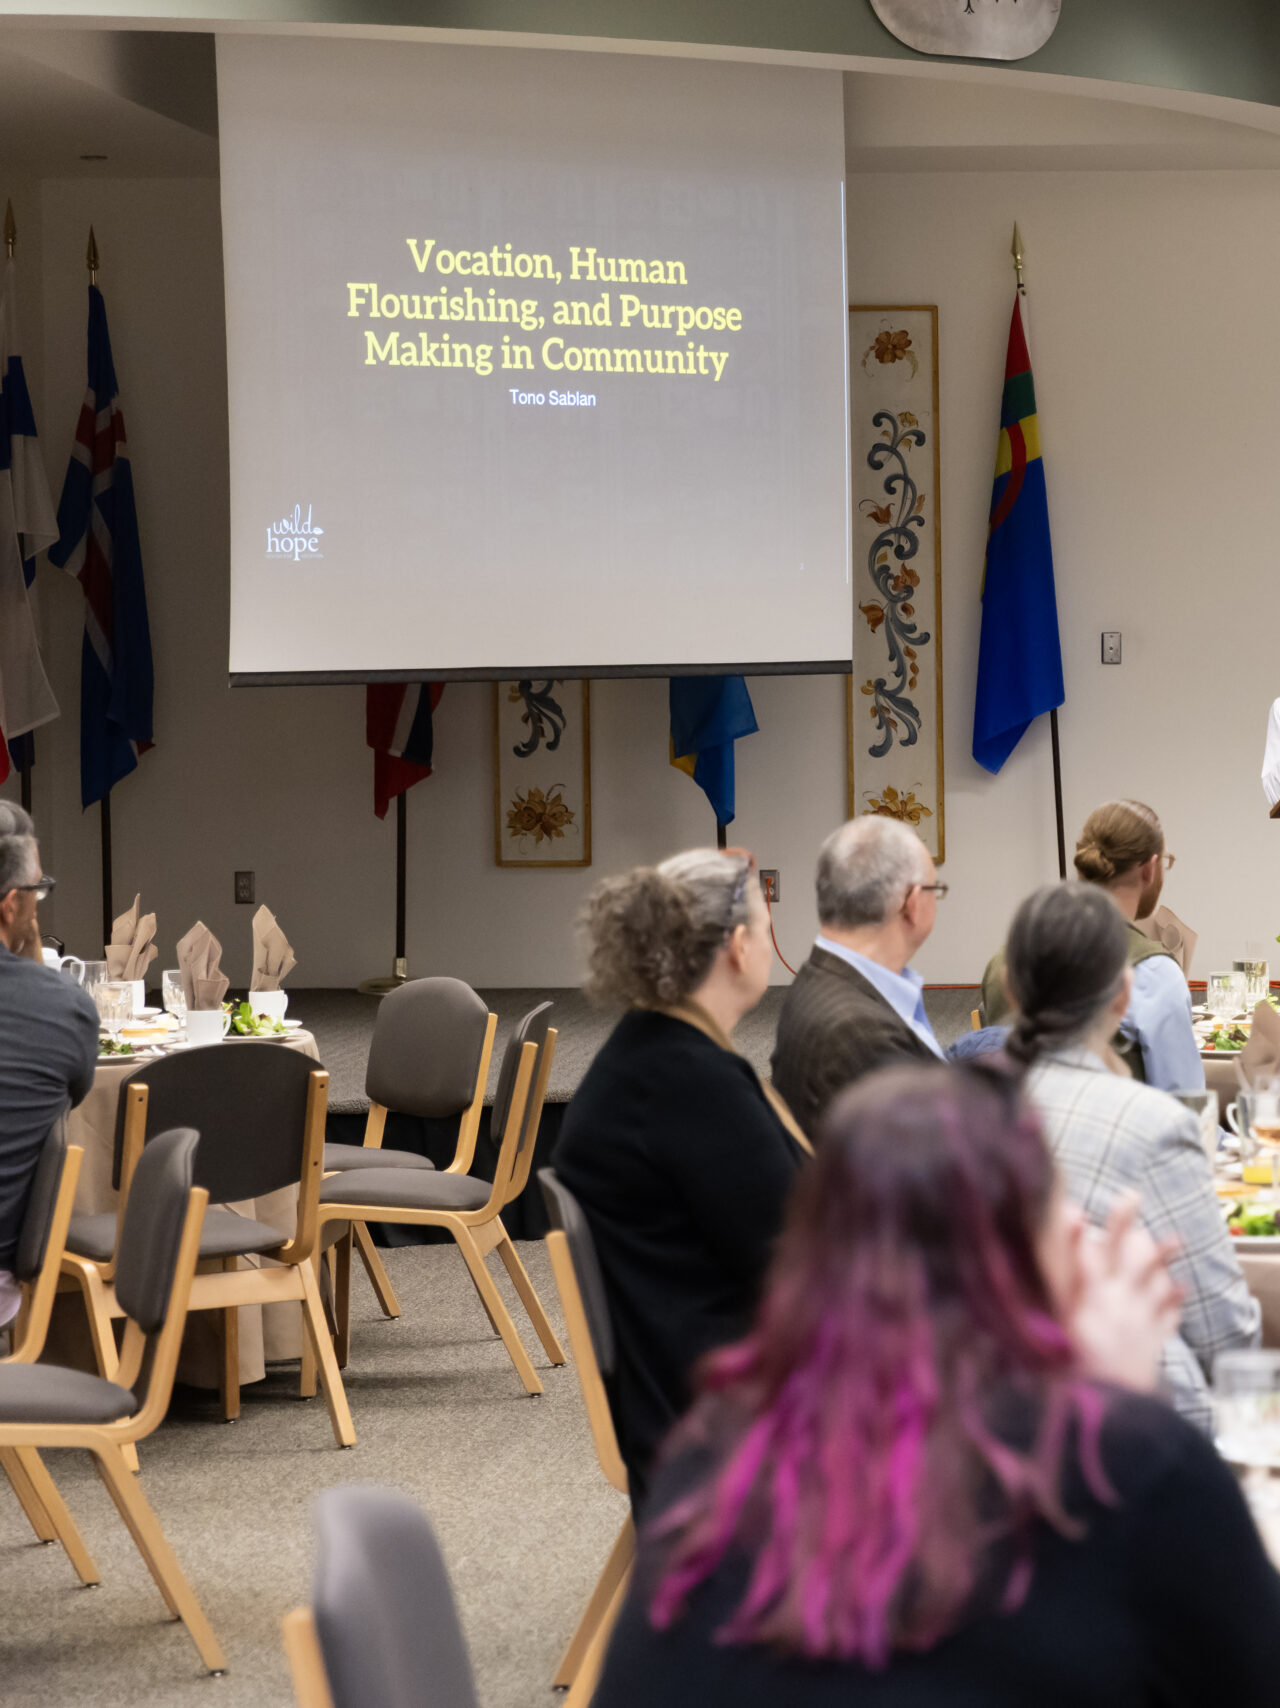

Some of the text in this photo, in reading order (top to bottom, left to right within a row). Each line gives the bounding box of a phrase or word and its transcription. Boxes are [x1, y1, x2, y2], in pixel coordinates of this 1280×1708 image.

[405, 237, 689, 285] Vocation, Human
[346, 281, 743, 337] Flourishing, and Purpose
[363, 330, 730, 382] Making in Community
[509, 388, 597, 407] Tono Sablan
[273, 503, 313, 535] wild
[266, 527, 319, 561] hope
